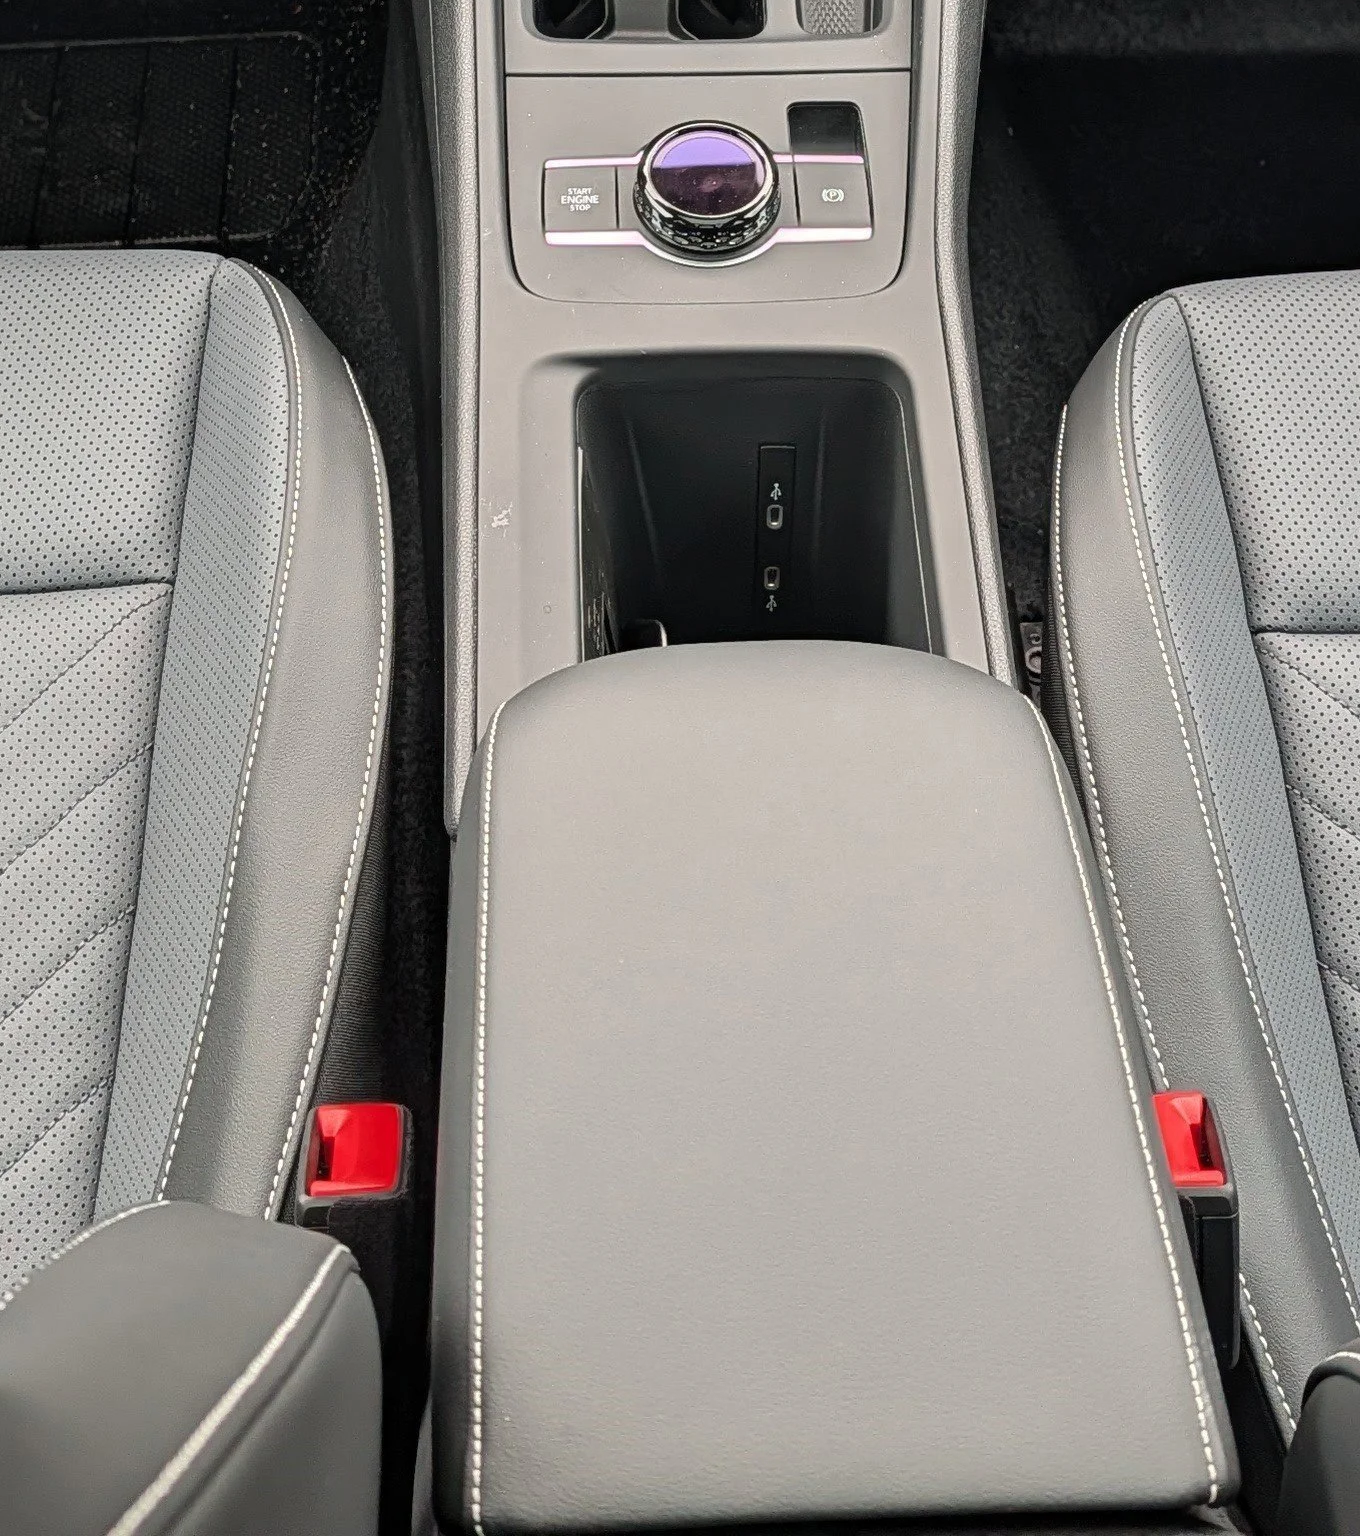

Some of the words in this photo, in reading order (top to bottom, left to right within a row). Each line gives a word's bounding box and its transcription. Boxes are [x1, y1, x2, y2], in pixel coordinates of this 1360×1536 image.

[568, 187, 592, 195] START
[561, 194, 599, 204] ENGINE
[570, 204, 591, 212] STOP
